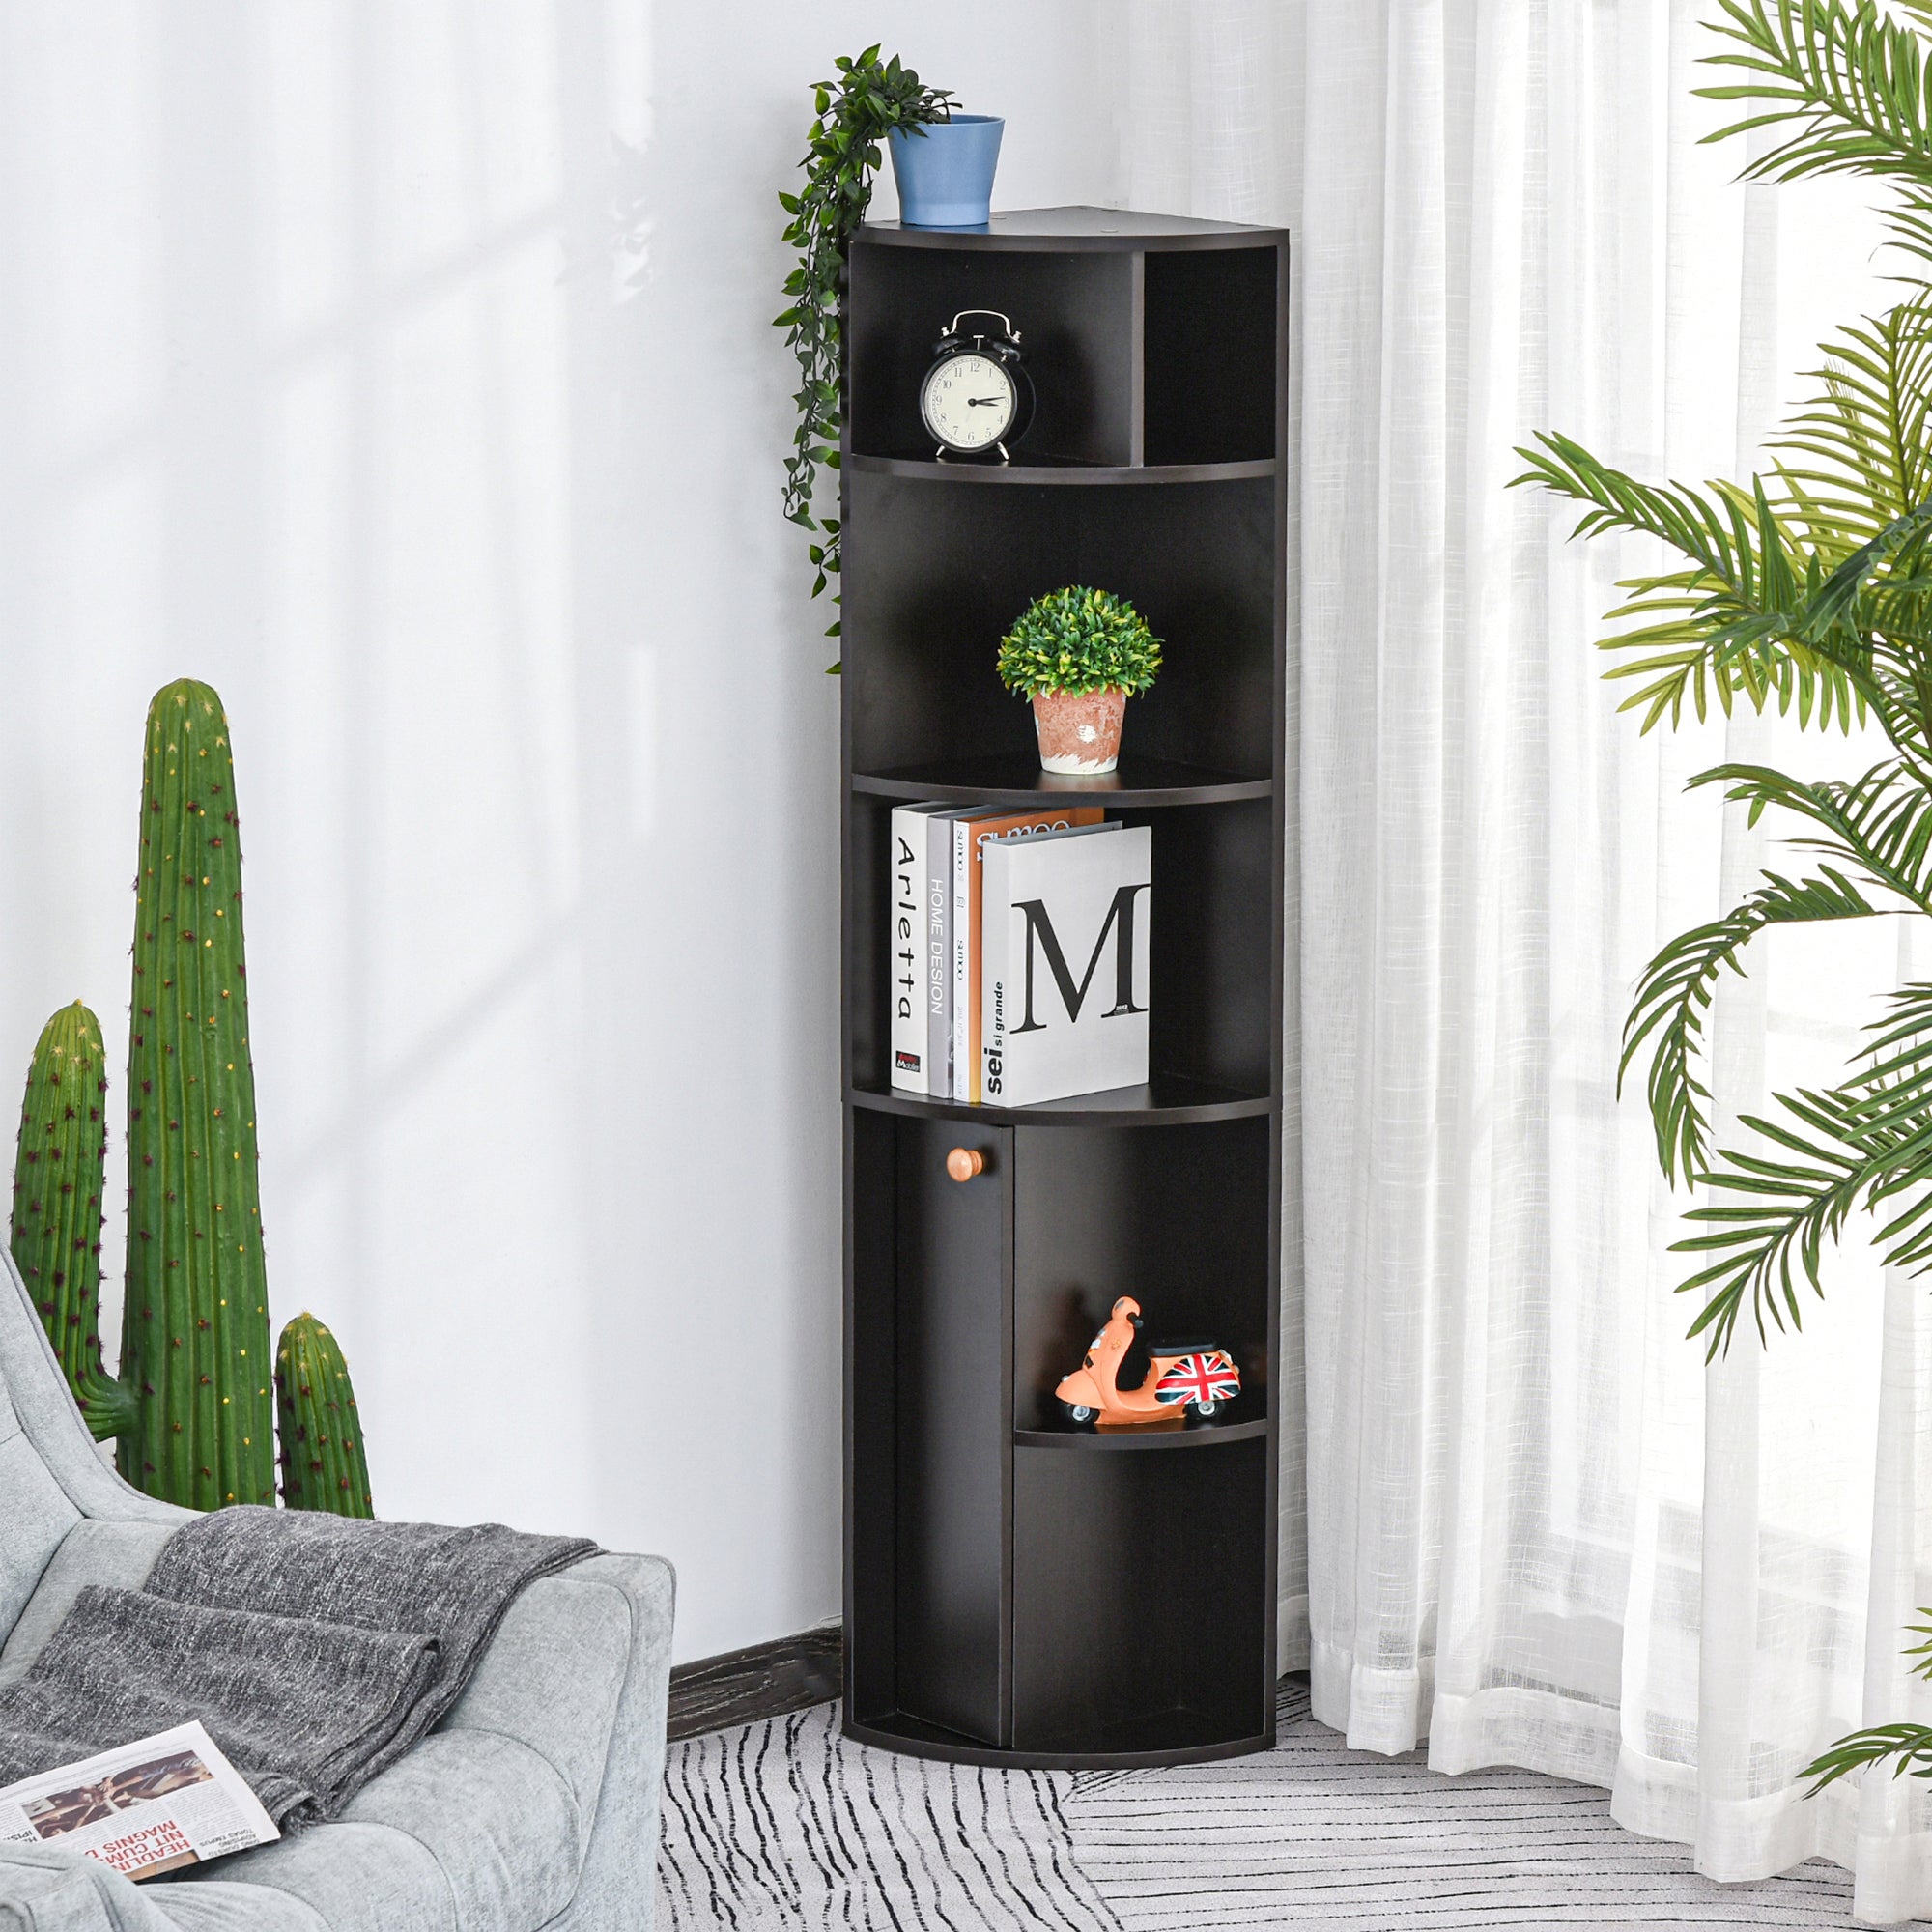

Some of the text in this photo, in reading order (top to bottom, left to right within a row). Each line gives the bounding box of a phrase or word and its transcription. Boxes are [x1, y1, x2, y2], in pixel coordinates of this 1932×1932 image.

[954, 367, 962, 377] 11
[970, 362, 980, 372] 12
[988, 368, 992, 378] 1
[943, 379, 952, 388] 10
[1000, 380, 1006, 390] 2
[936, 394, 943, 405] 9
[1005, 397, 1010, 408] 3
[940, 412, 947, 422] 8
[997, 414, 1003, 425] 4
[952, 425, 959, 436] 7
[968, 431, 975, 440] 6
[985, 427, 992, 438] 5
[931, 879, 943, 935] HOME
[898, 837, 916, 1018] Arletta
[1010, 884, 1150, 1034] M
[983, 980, 1005, 1095] sei si grande
[103, 1820, 177, 1853] MAGNIS
[100, 1830, 184, 1863] NIT CUM
